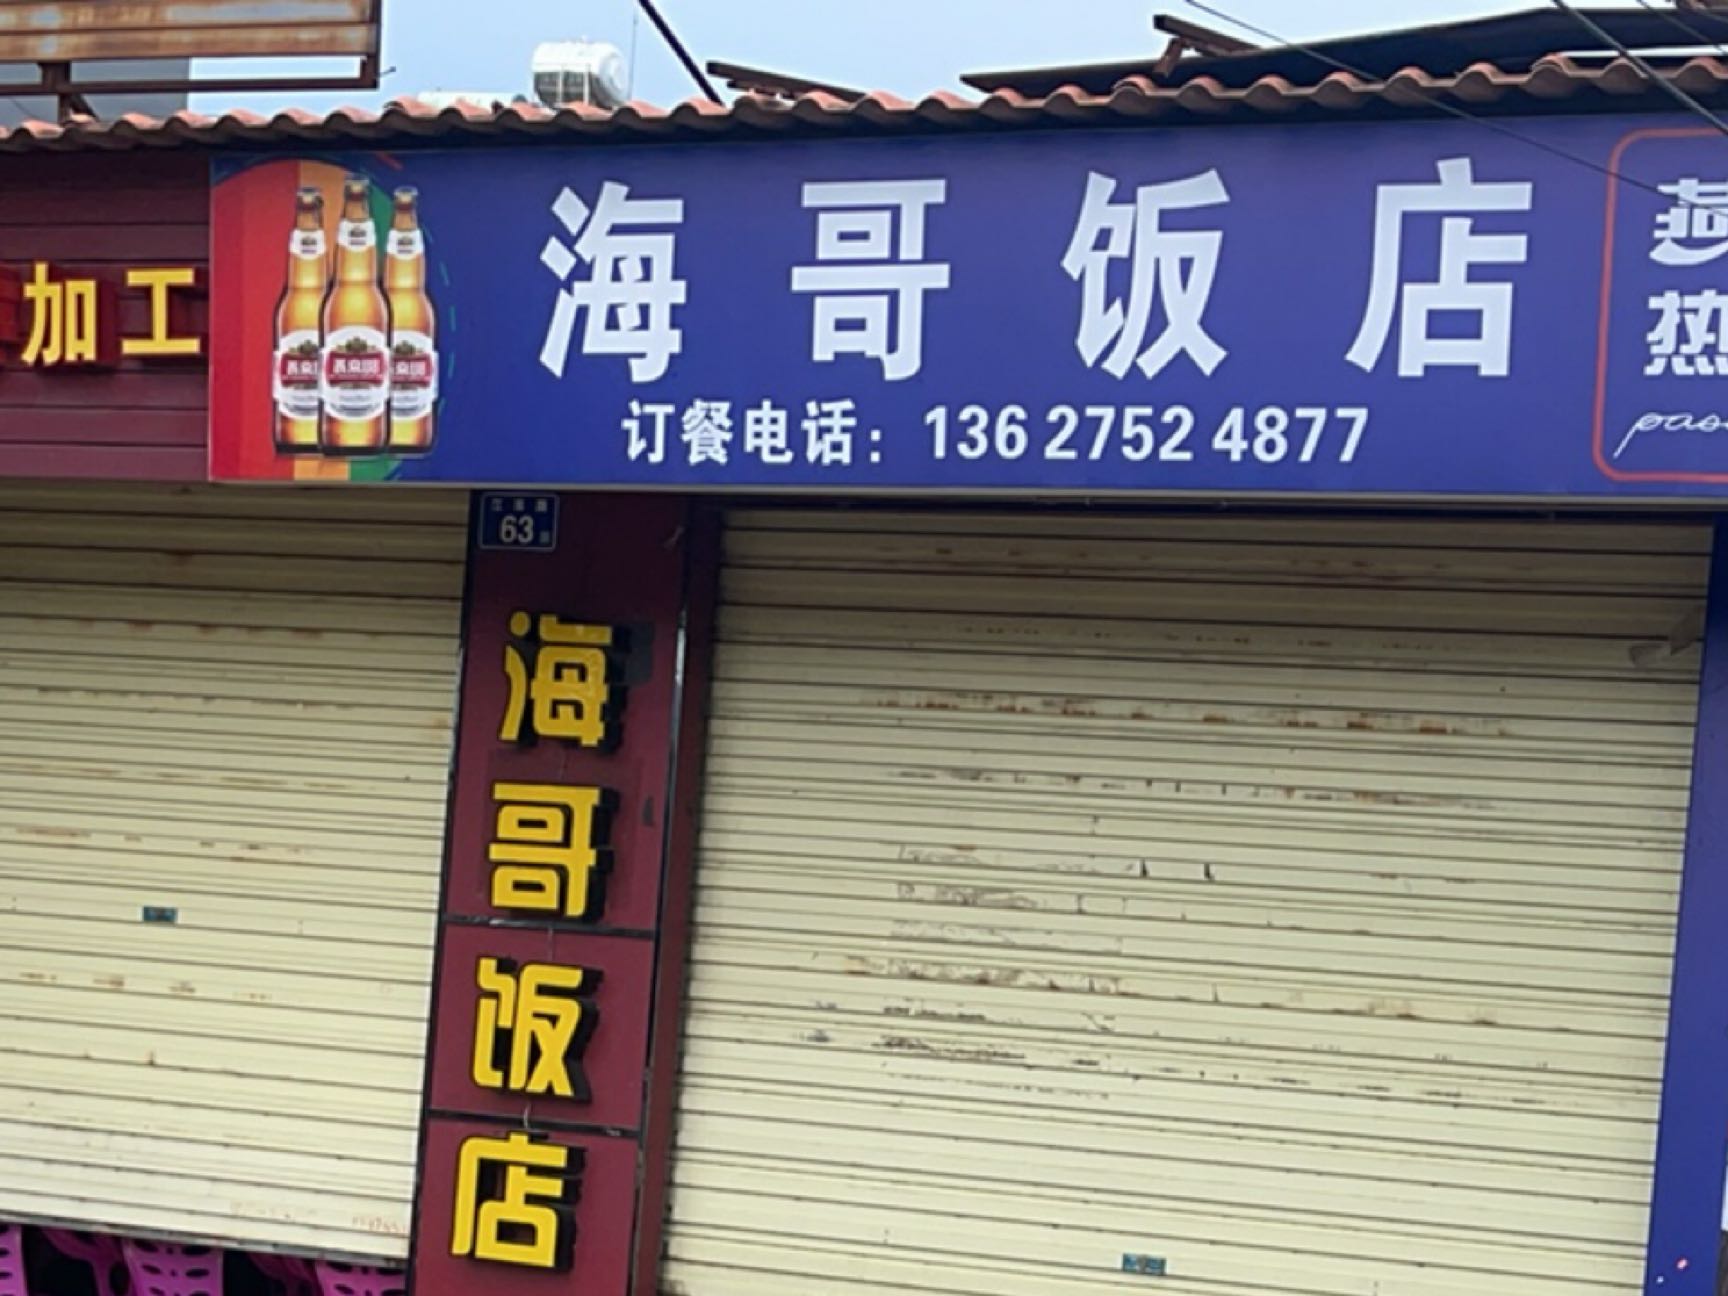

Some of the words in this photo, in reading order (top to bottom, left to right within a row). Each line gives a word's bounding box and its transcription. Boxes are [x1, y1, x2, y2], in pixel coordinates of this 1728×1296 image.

[21, 262, 200, 366] 加工
[539, 157, 1533, 382] 海哥饭店
[501, 514, 534, 543] 63
[451, 611, 613, 1269] 海哥饭店
